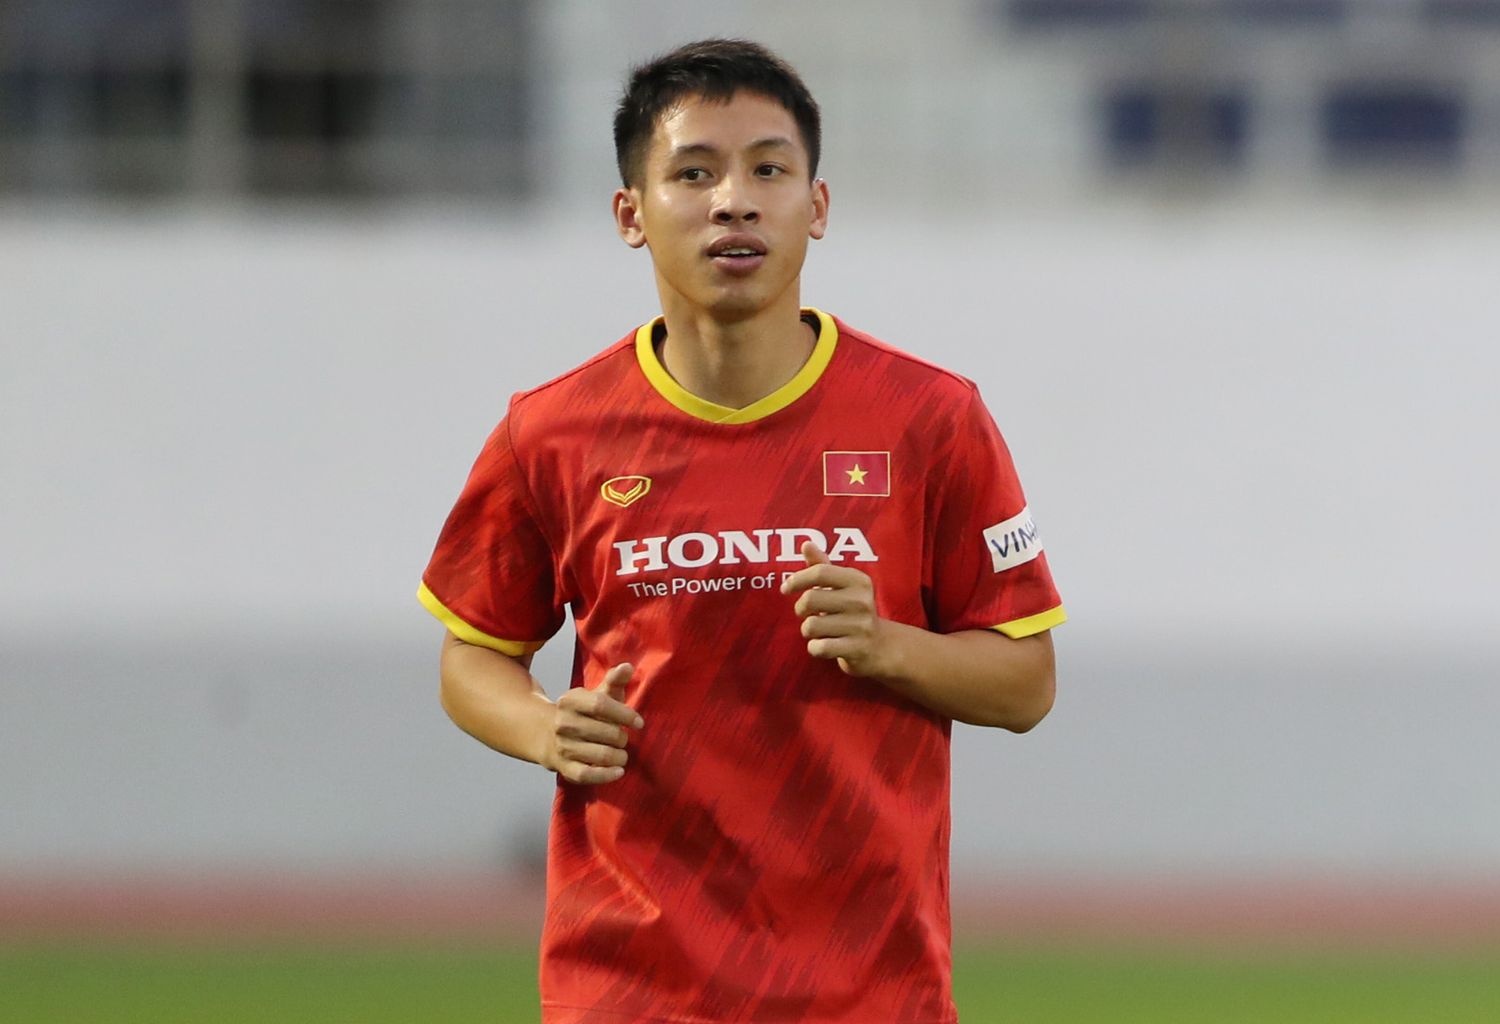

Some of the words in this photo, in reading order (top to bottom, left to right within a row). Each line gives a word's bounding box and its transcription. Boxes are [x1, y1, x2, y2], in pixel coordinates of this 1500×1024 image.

[613, 528, 878, 576] HONDA
[628, 581, 668, 598] The
[671, 576, 746, 595] Power
[750, 572, 775, 590] of
